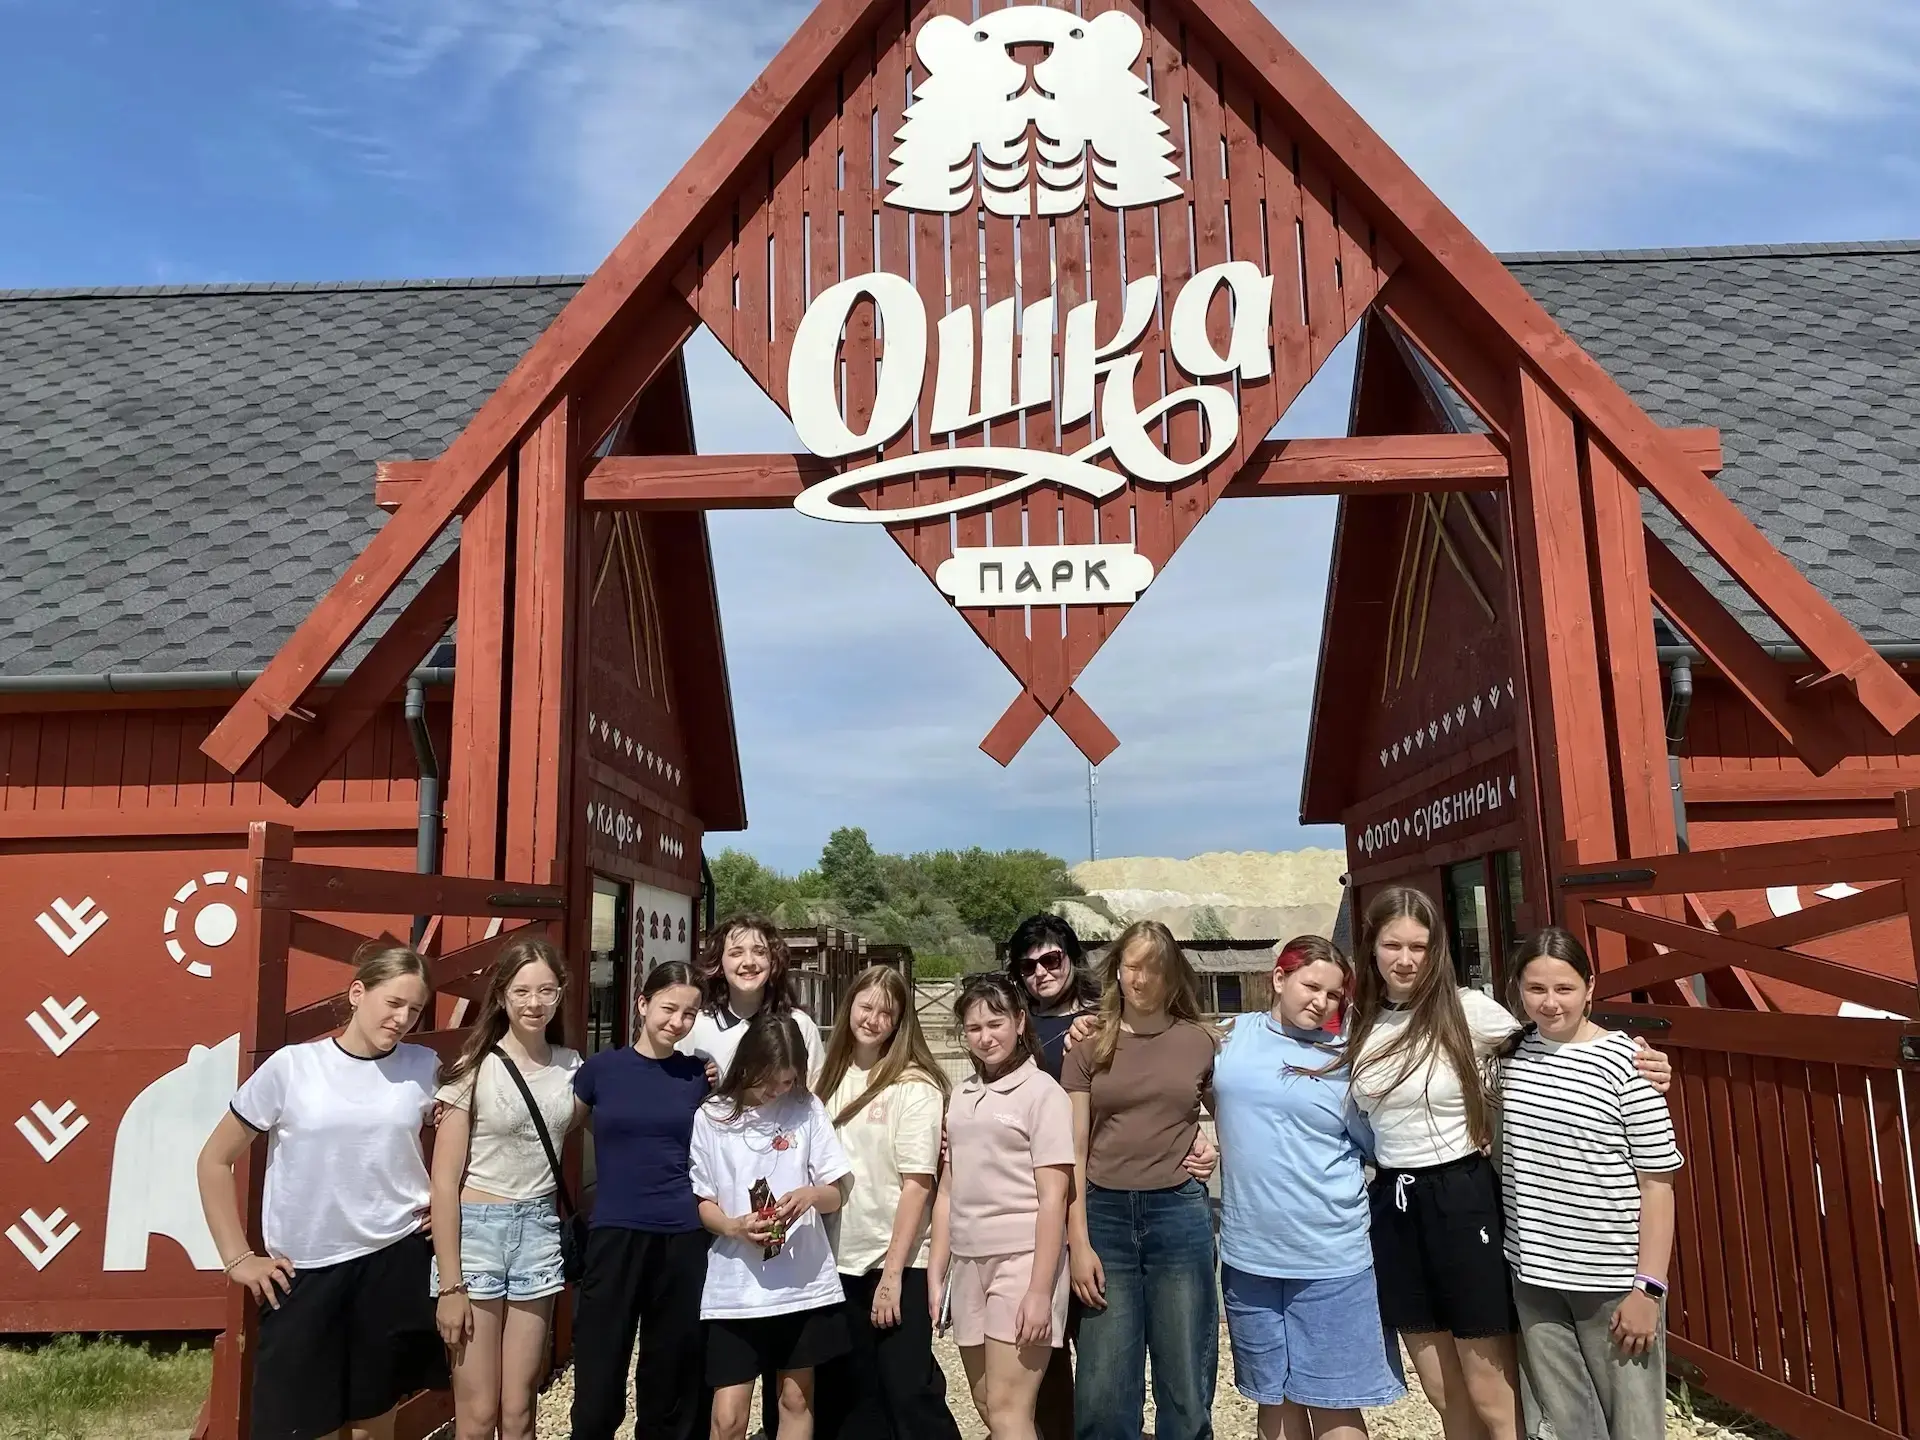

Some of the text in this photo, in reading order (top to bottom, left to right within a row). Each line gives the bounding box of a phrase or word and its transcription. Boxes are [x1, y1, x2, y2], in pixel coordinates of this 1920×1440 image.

[979, 560, 1110, 592] ПАРК
[596, 802, 634, 849] КАФЕ
[1365, 777, 1502, 858] ФОТО СУВЕНИРЫ
